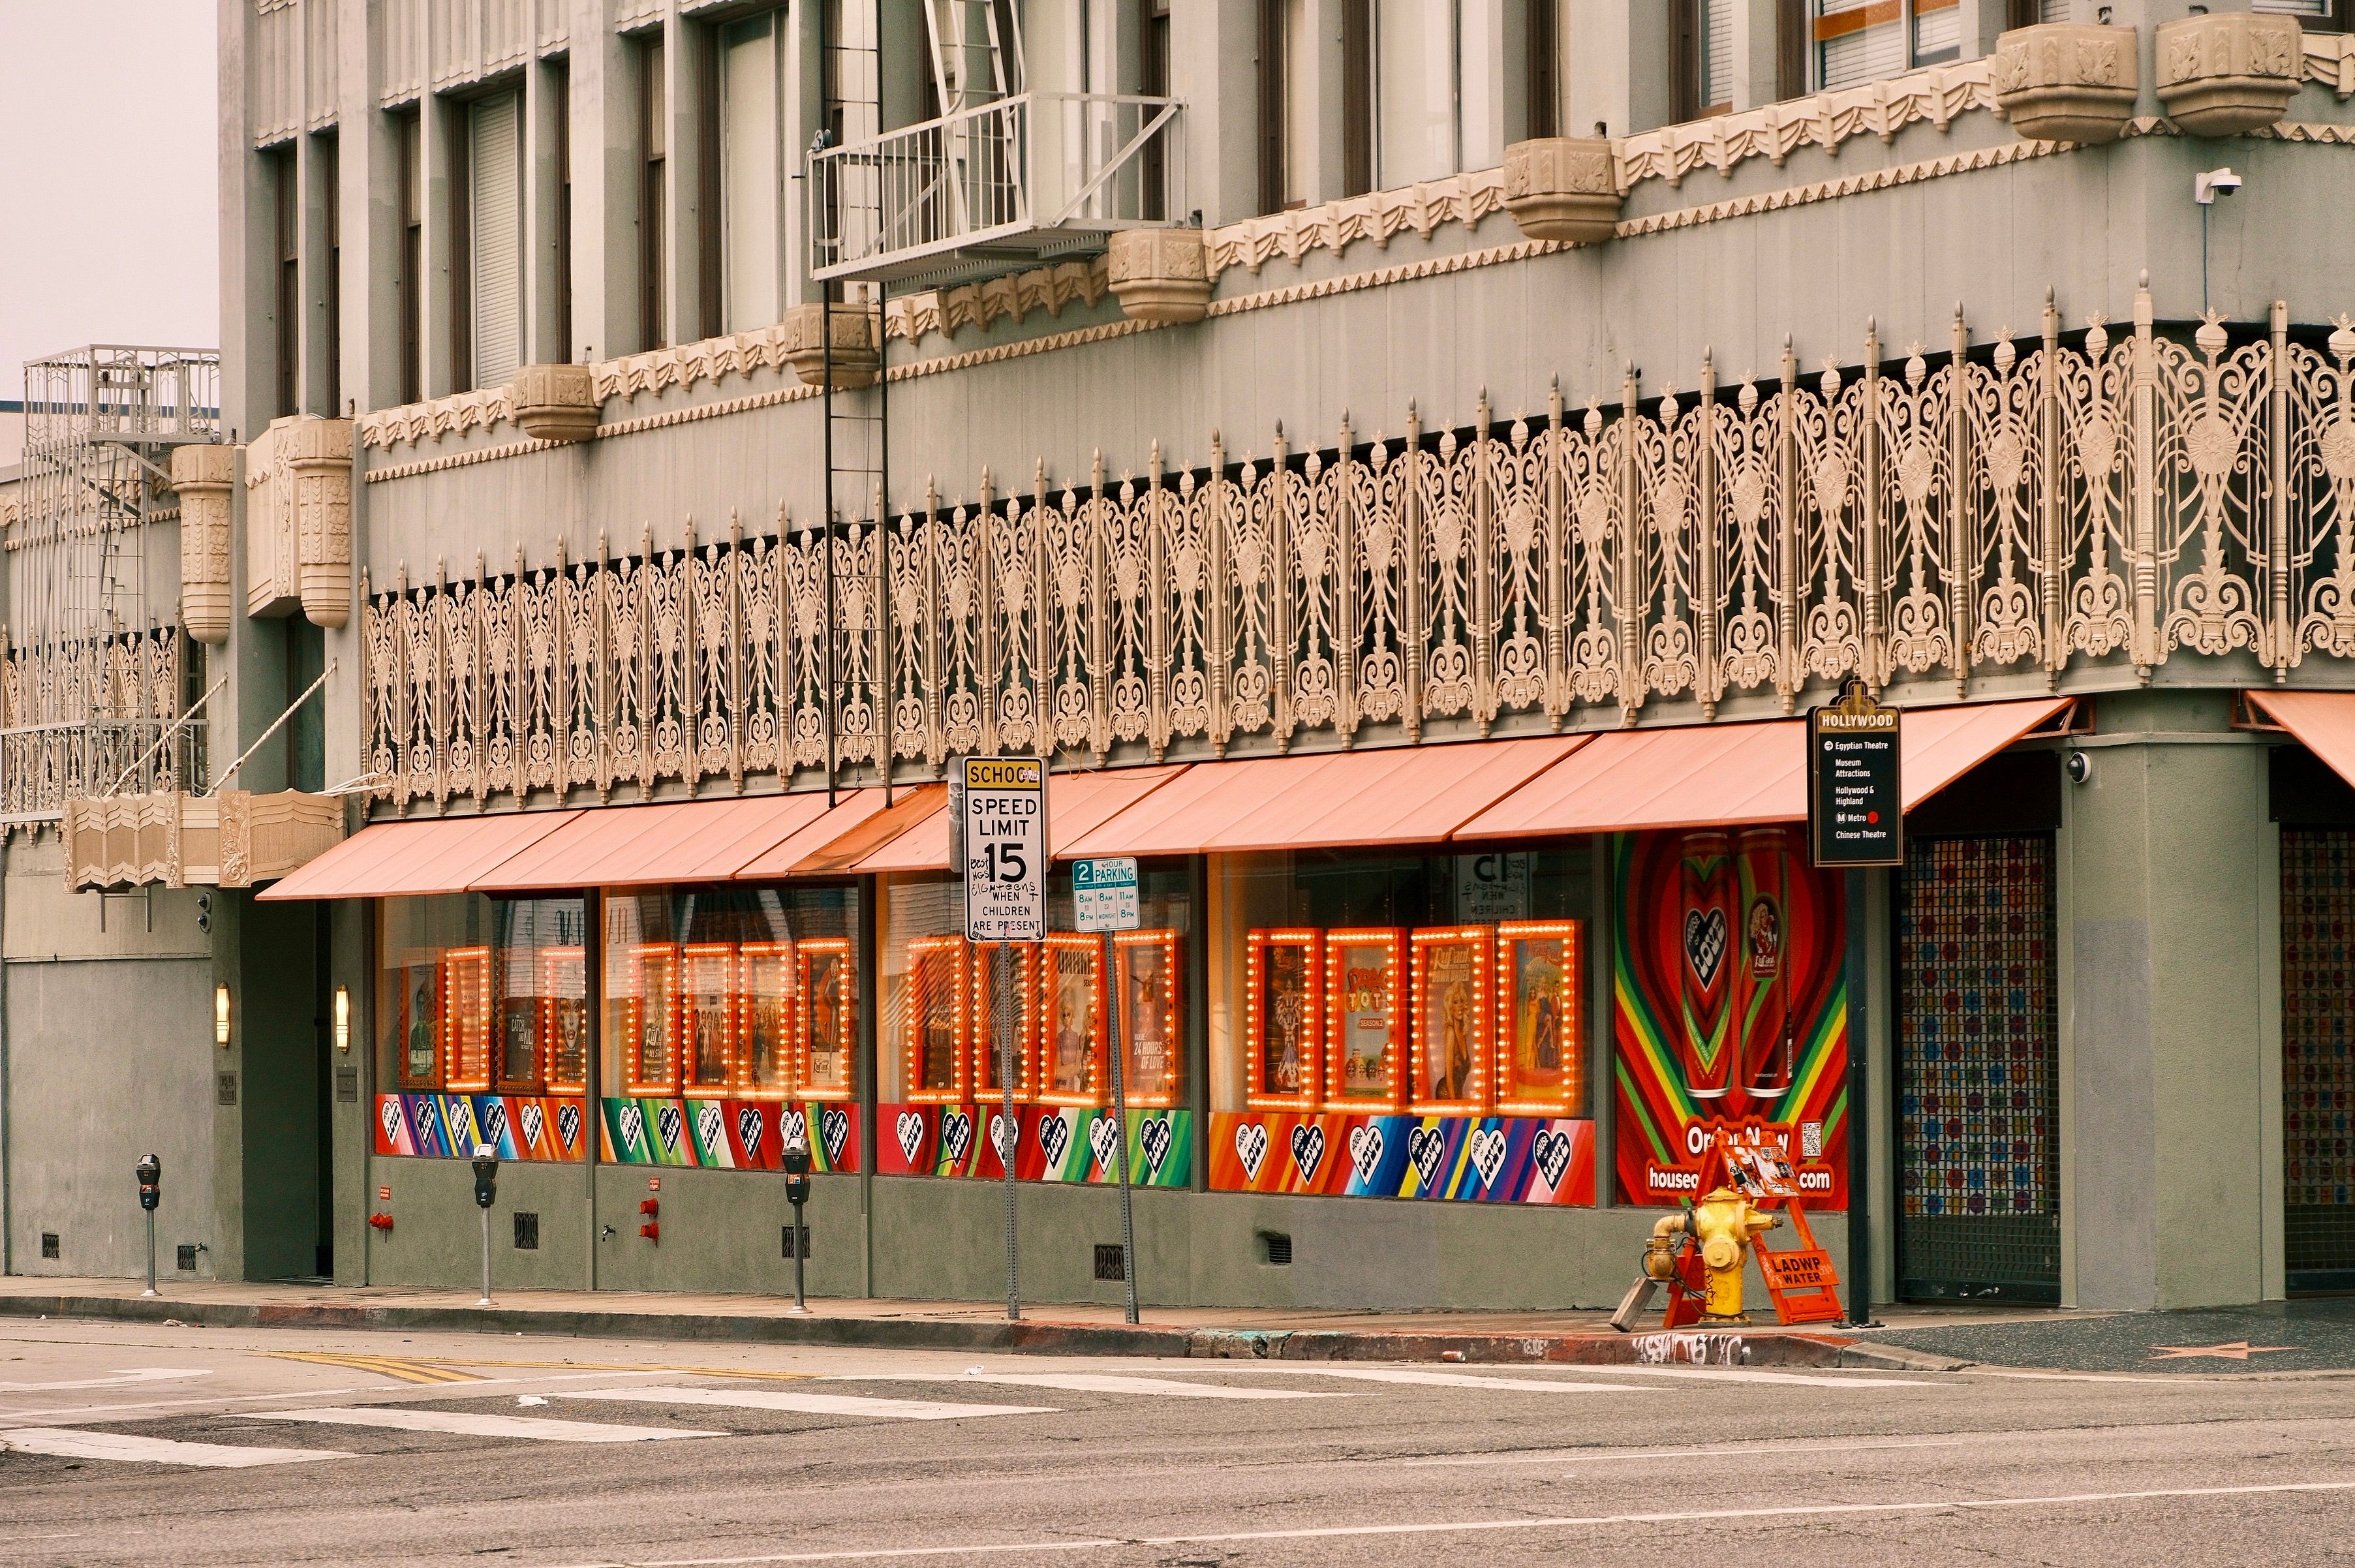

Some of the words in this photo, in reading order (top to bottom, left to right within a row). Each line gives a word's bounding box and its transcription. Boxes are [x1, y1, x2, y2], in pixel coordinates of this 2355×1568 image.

[1822, 715, 1894, 727] HOLLYWOOD
[1835, 741, 1862, 752] Egyptian
[1836, 786, 1868, 795] Hollywood
[972, 798, 1037, 814] SPEED
[1836, 797, 1863, 807] Highland
[979, 820, 1030, 836] LIMIT
[1848, 814, 1867, 822] Metro
[1836, 830, 1860, 838] Chinese
[1862, 830, 1886, 838] Theatre
[984, 843, 1026, 882] 15
[1078, 863, 1089, 881] 2
[1096, 867, 1133, 882] PARKING
[993, 892, 1019, 901] WHEN
[983, 906, 1030, 915] CHILDREN
[973, 921, 991, 930] ARE
[1687, 915, 1701, 946] HOUSE
[1695, 935, 1700, 945] OF
[1695, 914, 1725, 978] LOVE
[1134, 1042, 1142, 1055] 24
[1143, 1041, 1162, 1055] HOURS
[1141, 1056, 1149, 1069] OF
[1150, 1055, 1164, 1069] LOVE
[388, 1105, 400, 1140] LOVE
[422, 1105, 435, 1141] LOVE
[455, 1107, 469, 1141] LOVE
[491, 1107, 505, 1143] LOVE
[527, 1109, 541, 1145] LOVE
[564, 1109, 578, 1145] LOVE
[626, 1110, 640, 1147] LOVE
[664, 1111, 679, 1148] LOVE
[705, 1112, 720, 1150] LOVE
[745, 1113, 761, 1152] LOVE
[945, 1118, 954, 1136] HOUSE
[992, 1119, 1002, 1138] HOUSE
[1041, 1120, 1051, 1141] HOUSE
[1091, 1121, 1101, 1142] HOUSE
[830, 1115, 847, 1155] LOVE
[904, 1116, 922, 1157] LOVE
[950, 1118, 968, 1158] LOVE
[1047, 1120, 1066, 1163] LOVE
[1098, 1122, 1117, 1165] LOVE
[1143, 1124, 1153, 1144] HOUSE
[1238, 1128, 1248, 1149] HOUSE
[1293, 1130, 1304, 1151] HOUSE
[1352, 1131, 1362, 1152] HOUSE
[1411, 1133, 1423, 1155] HOUSE
[1473, 1134, 1484, 1156] HOUSE
[1148, 1124, 1169, 1167] LOVE
[1244, 1129, 1265, 1173] LOVE
[1300, 1130, 1323, 1175] LOVE
[1359, 1131, 1381, 1177] LOVE
[1418, 1133, 1442, 1180] LOVE
[1537, 1135, 1548, 1158] HOUSE
[1480, 1134, 1505, 1182] LOVE
[1544, 1135, 1570, 1184] LOVE
[1772, 1257, 1821, 1273] LADWP
[1783, 1272, 1822, 1284] WATER
